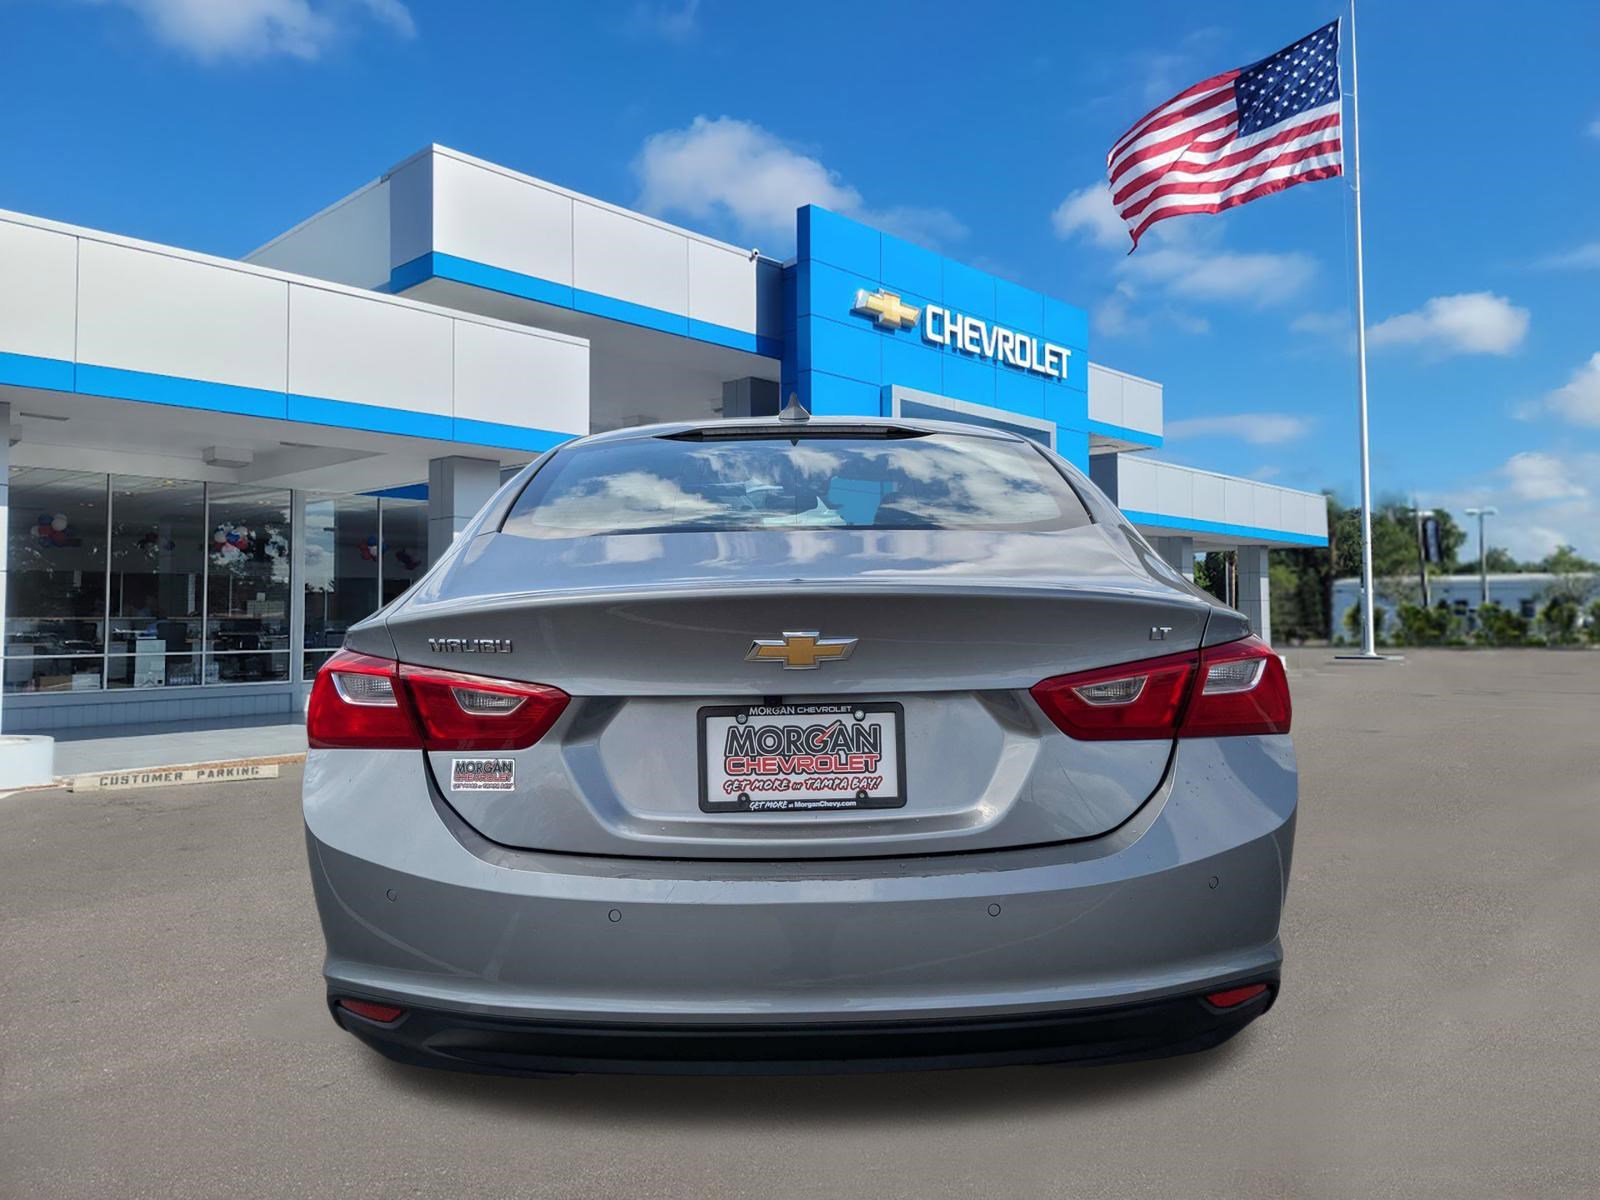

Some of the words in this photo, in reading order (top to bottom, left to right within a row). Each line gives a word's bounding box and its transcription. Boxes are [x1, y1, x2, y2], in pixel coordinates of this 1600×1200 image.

[926, 304, 1072, 379] CHEVROLET
[1150, 627, 1172, 640] LT
[428, 638, 512, 653] MALIBU
[750, 706, 795, 715] MORGAN
[725, 721, 881, 756] MORGAN
[455, 760, 512, 773] MORGAN
[725, 754, 880, 775] CHEVROLET
[100, 771, 183, 786] CUSTOMER
[197, 766, 259, 778] PARKING
[723, 779, 750, 794] GET
[750, 778, 791, 791] MORE
[804, 776, 849, 791] TAMPA
[850, 776, 883, 790] BAY!
[749, 802, 765, 811] GET
[765, 801, 787, 809] MORE
[794, 801, 857, 809] MorganChevy.com
